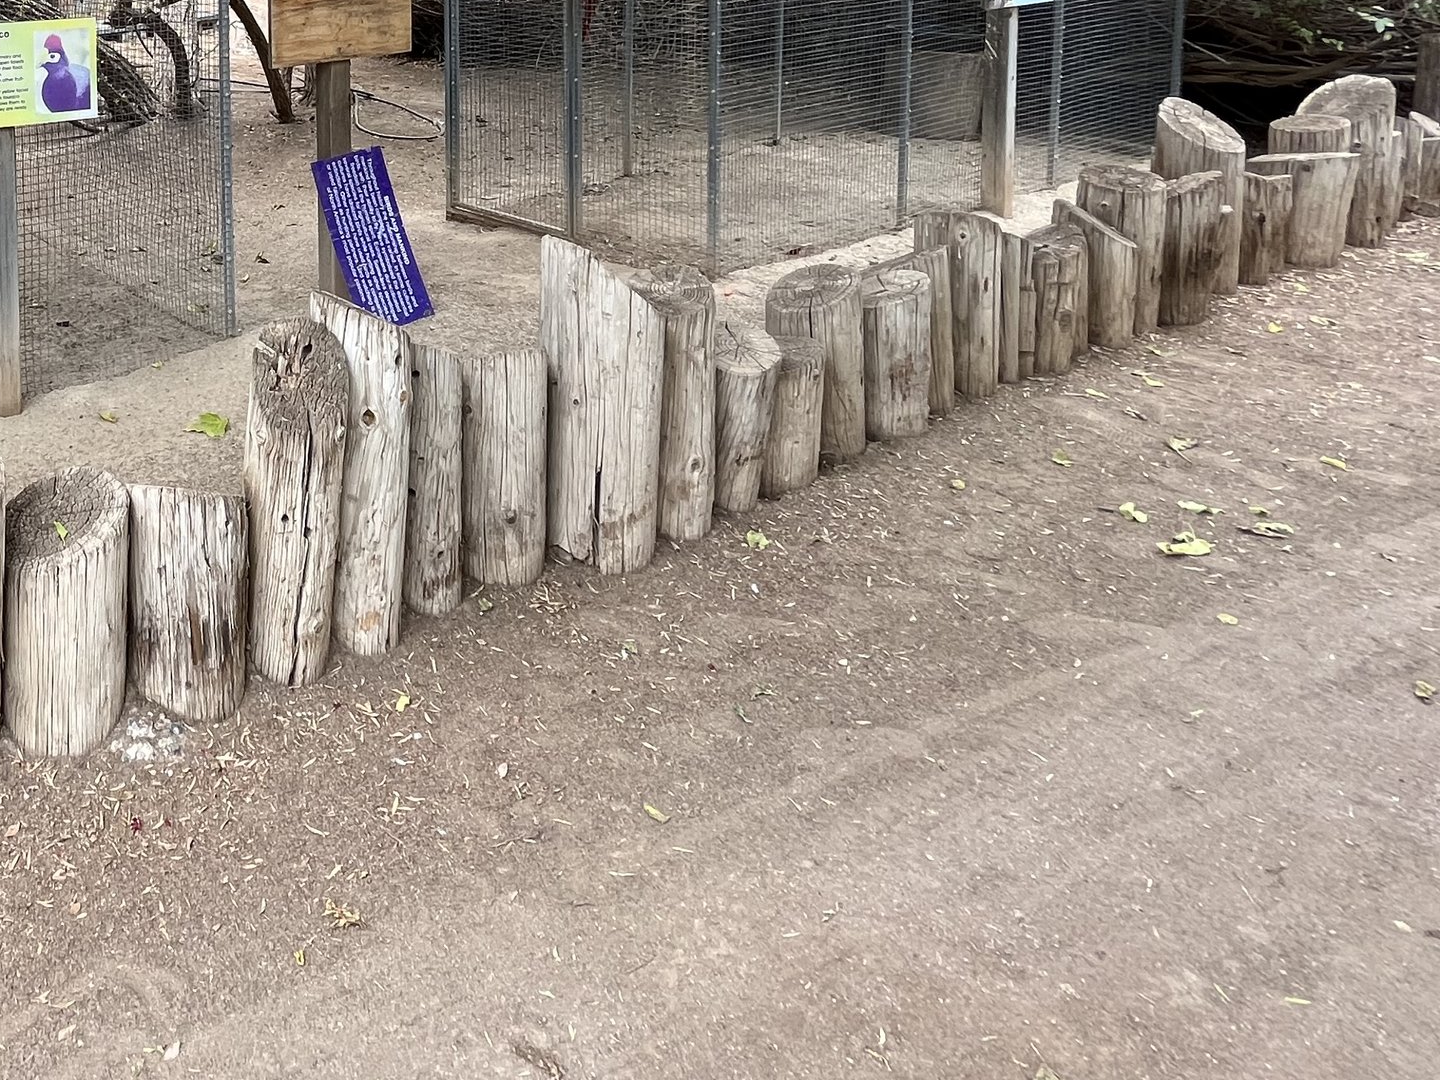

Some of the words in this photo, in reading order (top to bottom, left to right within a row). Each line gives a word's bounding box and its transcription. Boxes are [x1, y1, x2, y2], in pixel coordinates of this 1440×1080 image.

[383, 195, 395, 217] BIRDS
[390, 217, 399, 233] AND
[395, 232, 410, 266] MANKIND
